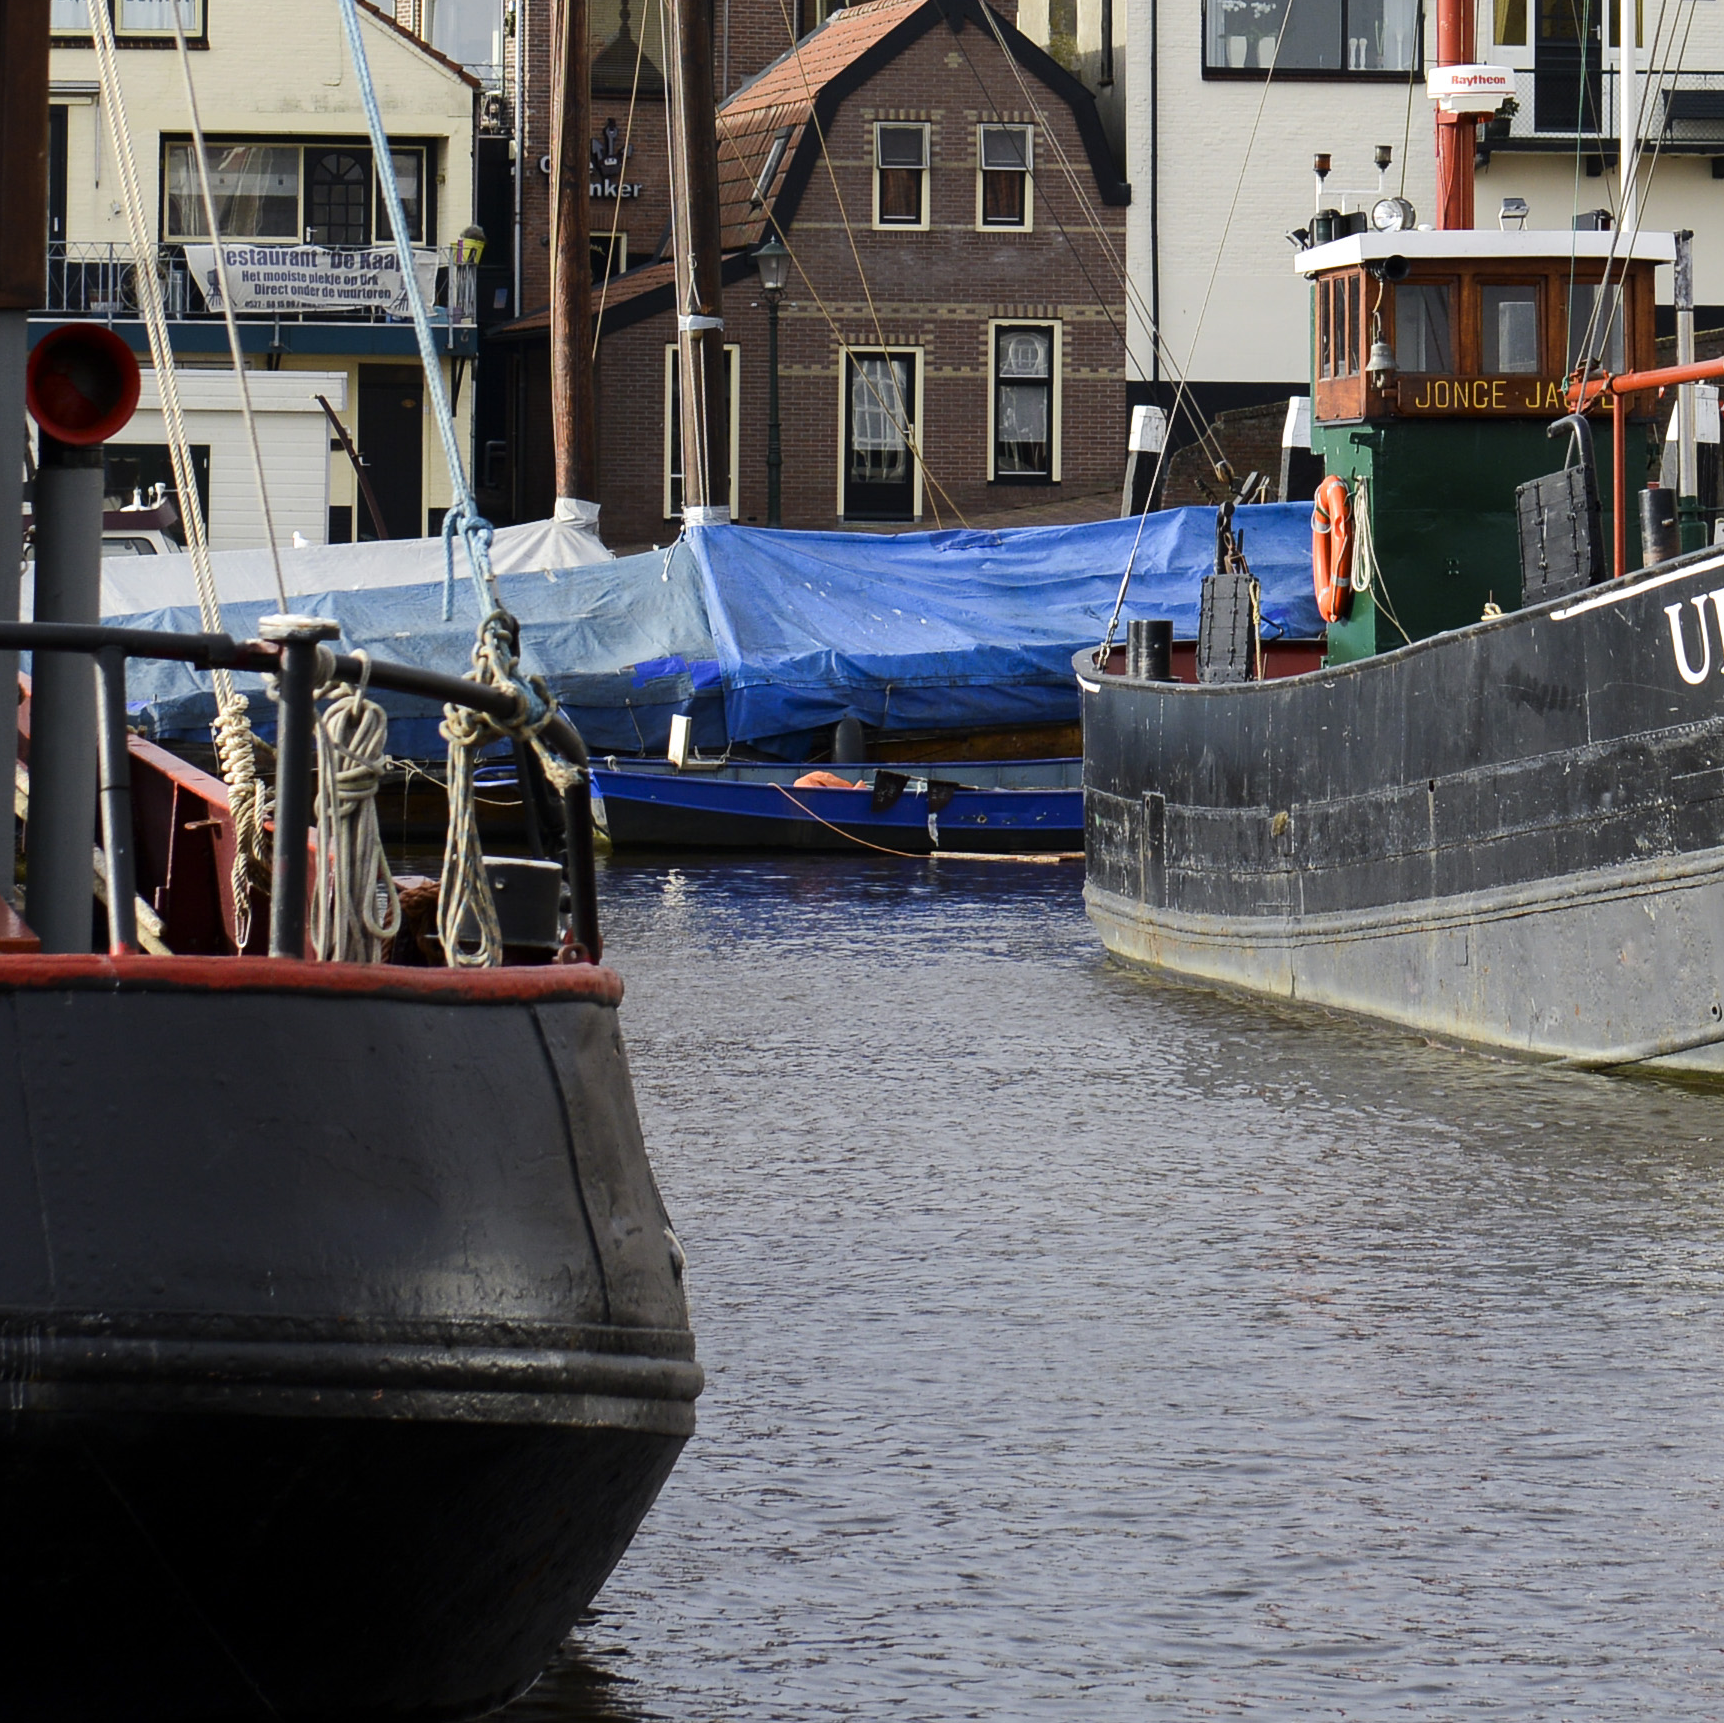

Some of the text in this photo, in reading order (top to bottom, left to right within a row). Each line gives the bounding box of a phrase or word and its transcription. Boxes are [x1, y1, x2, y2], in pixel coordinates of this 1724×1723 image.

[1451, 74, 1506, 86] Raytheon
[590, 178, 643, 198] nker
[220, 248, 318, 268] estaurant
[242, 270, 379, 287] Het mooiste plekje op Urk
[254, 283, 391, 299] Direct onder de vuurtoren
[1415, 380, 1507, 409] JONGE
